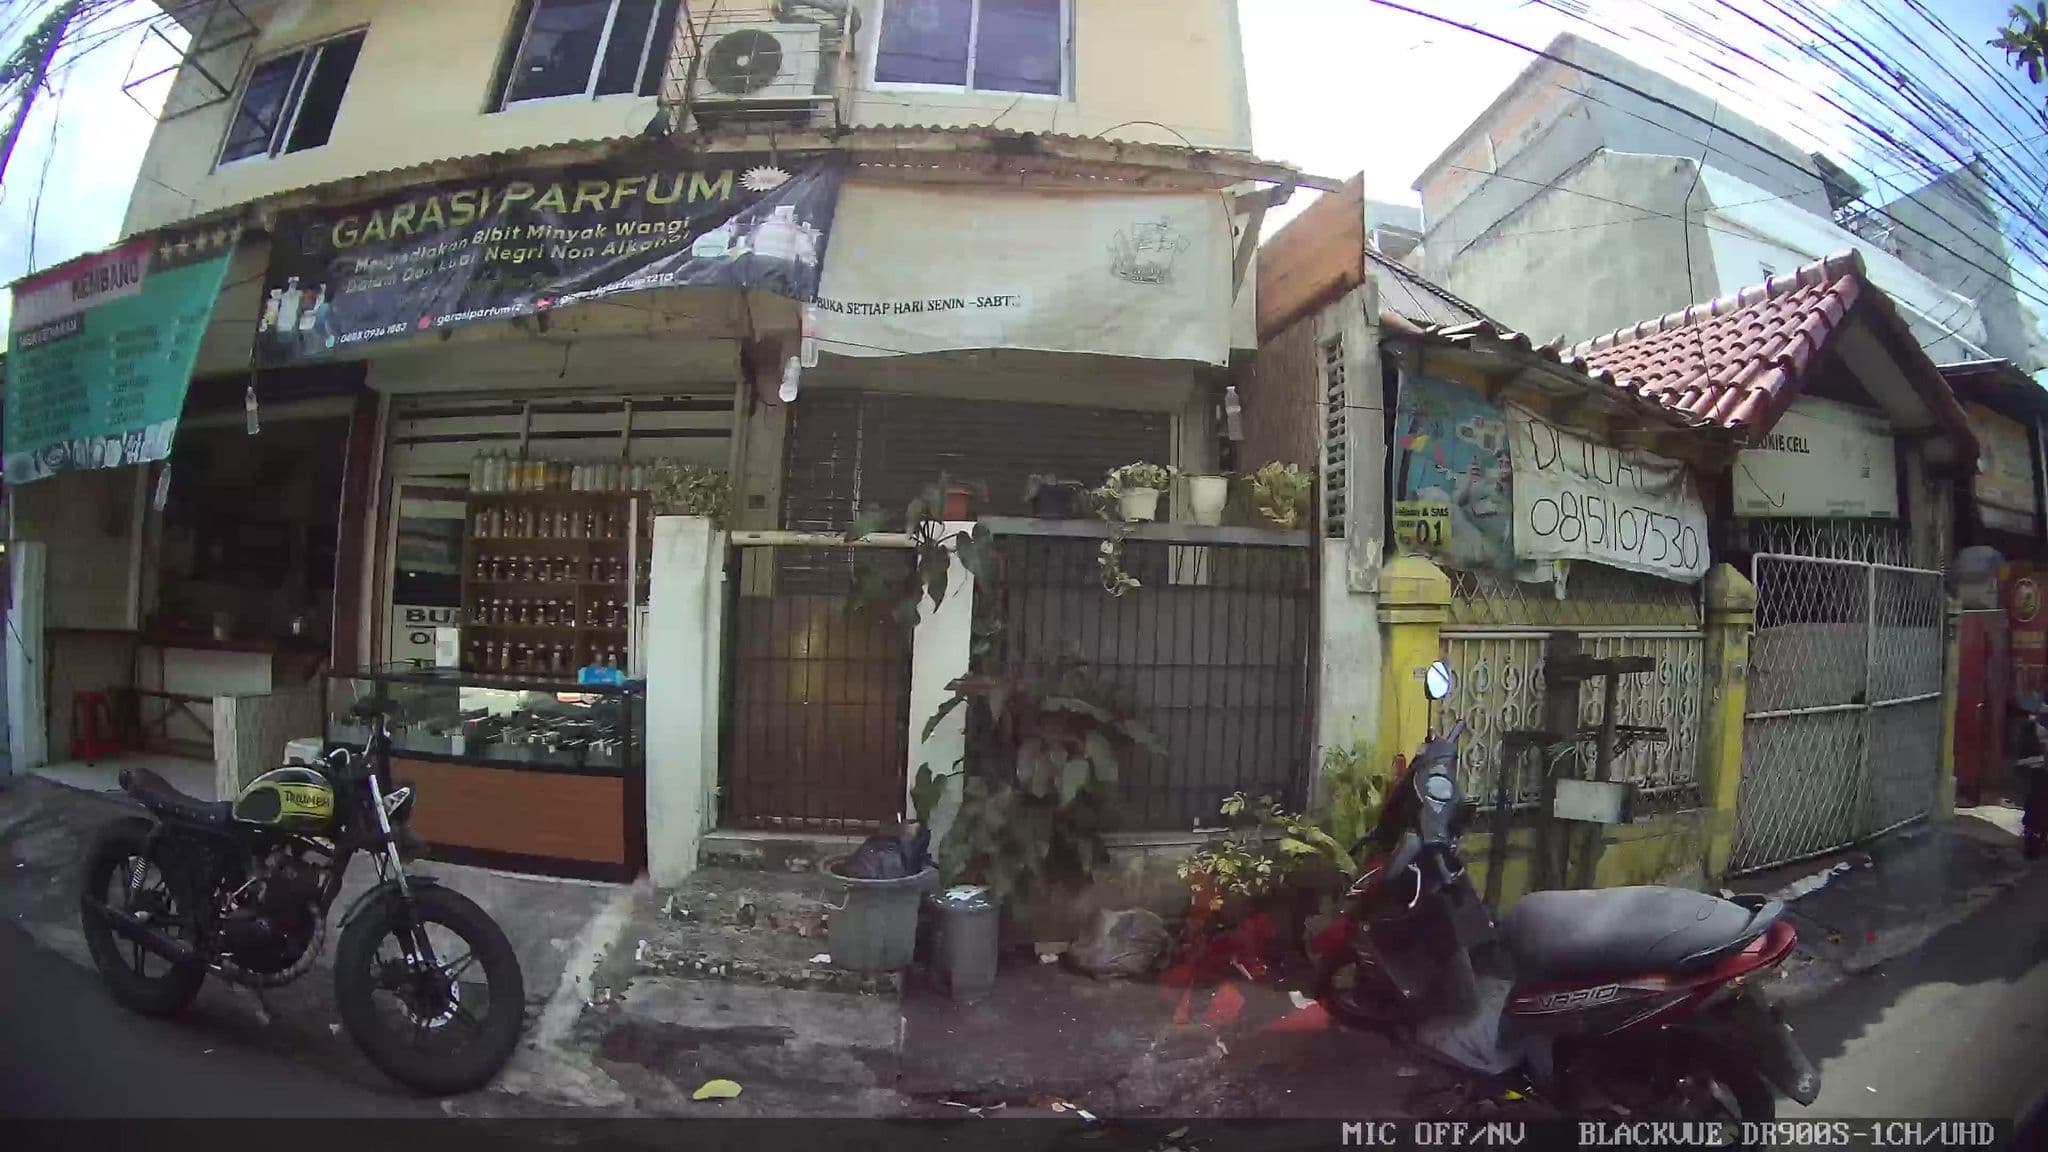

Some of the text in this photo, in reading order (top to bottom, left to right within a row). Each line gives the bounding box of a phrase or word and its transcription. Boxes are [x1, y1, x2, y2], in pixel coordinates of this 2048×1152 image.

[332, 169, 735, 249] GARASI PARFUM
[526, 223, 607, 243] Minyak
[616, 216, 691, 237] Wangi
[551, 246, 595, 260] Non
[816, 297, 844, 314] BUKA
[847, 302, 890, 316] SETIAP
[894, 301, 923, 314] HARI
[927, 298, 965, 312] SENIN
[1787, 436, 1810, 454] CELL
